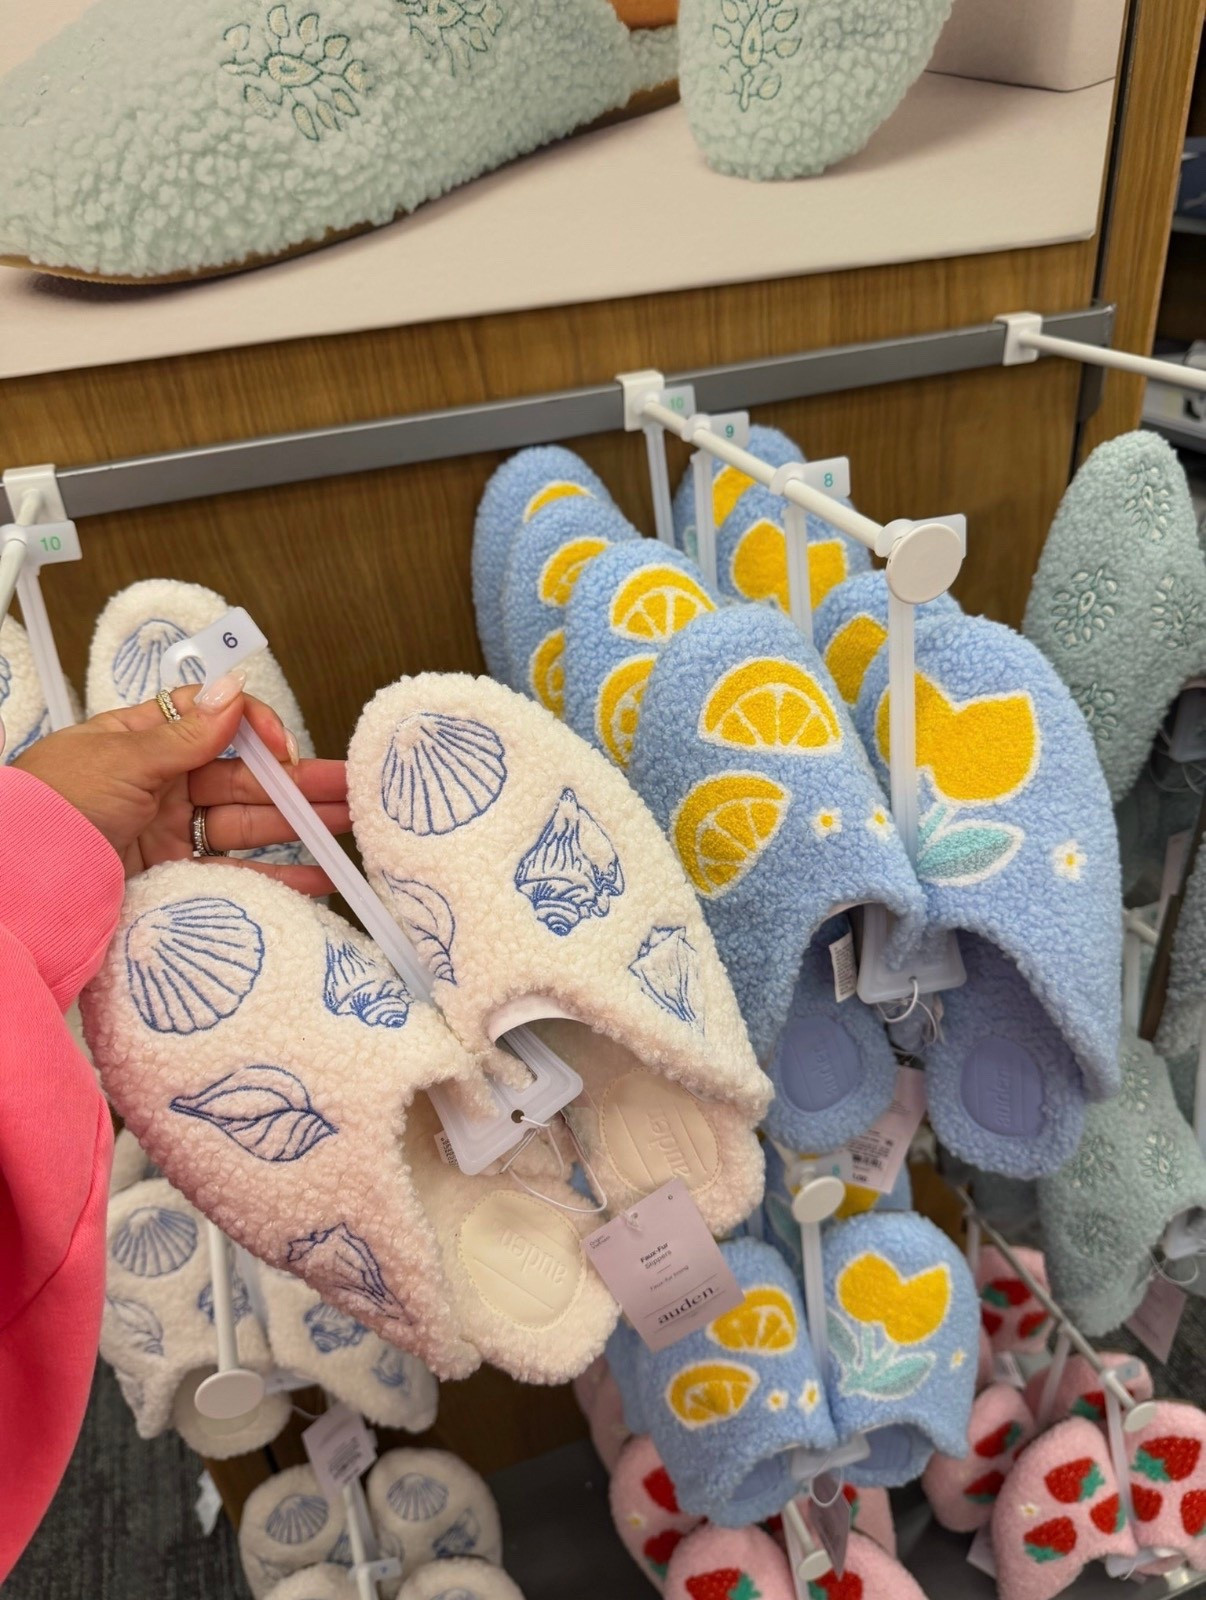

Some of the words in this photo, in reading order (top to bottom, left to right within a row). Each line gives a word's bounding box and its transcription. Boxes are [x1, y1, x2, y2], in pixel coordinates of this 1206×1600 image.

[669, 396, 685, 410] 10
[725, 424, 735, 439] 9
[823, 472, 834, 488] 8
[39, 535, 62, 552] 10
[222, 631, 239, 649] 6
[498, 1228, 568, 1286] auden
[640, 1242, 669, 1264] Faux-Fur
[644, 1250, 673, 1270] Slippers
[657, 1286, 714, 1326] auden
